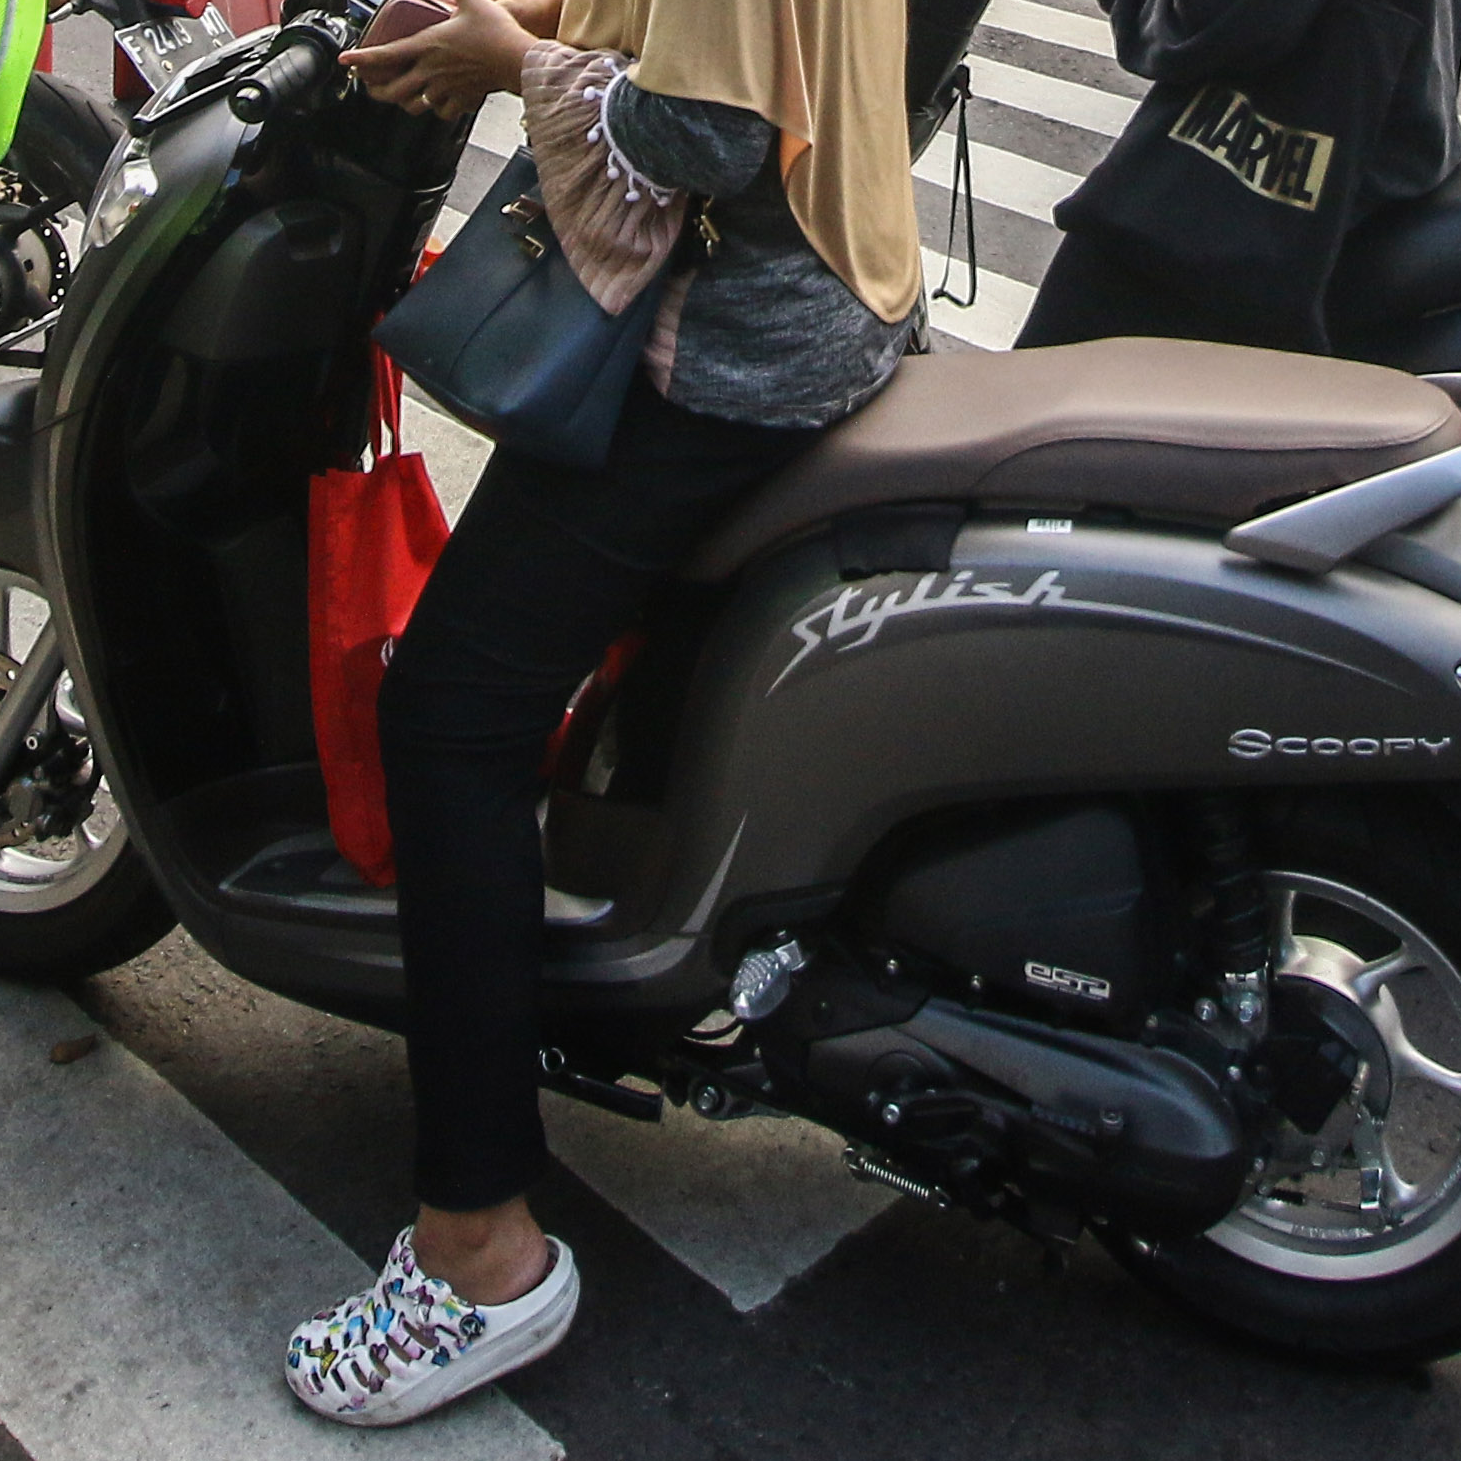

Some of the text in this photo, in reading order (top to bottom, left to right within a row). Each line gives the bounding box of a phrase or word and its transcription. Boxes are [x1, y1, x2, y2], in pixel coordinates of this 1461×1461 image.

[123, 35, 143, 64] F
[1179, 92, 1315, 205] MARVEL
[765, 570, 1069, 697] Stylish
